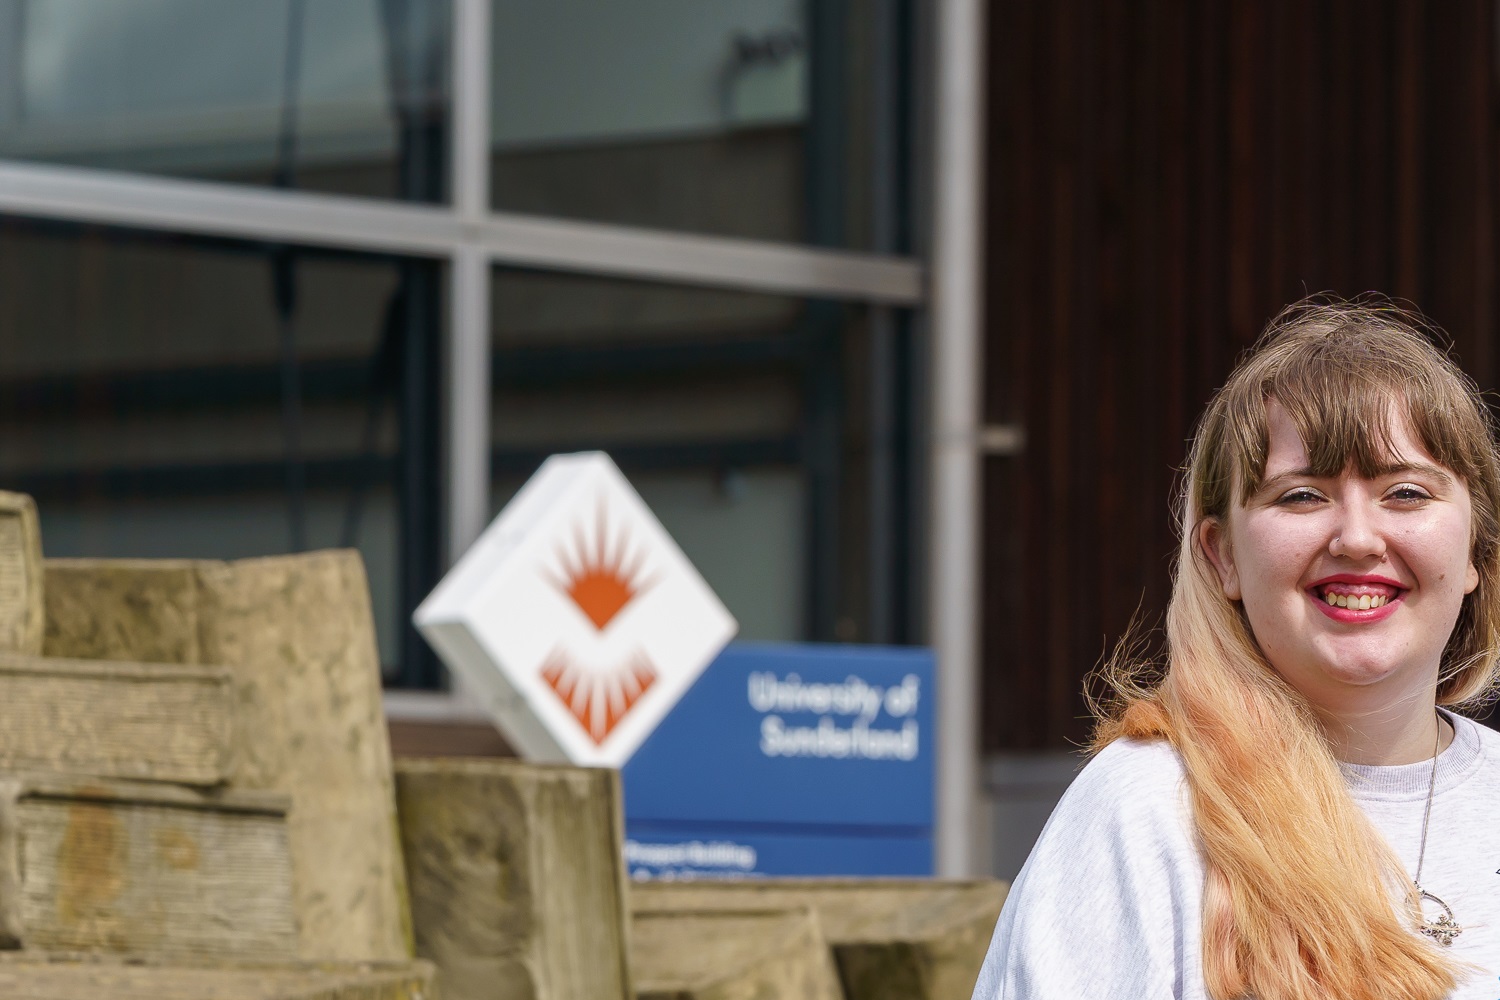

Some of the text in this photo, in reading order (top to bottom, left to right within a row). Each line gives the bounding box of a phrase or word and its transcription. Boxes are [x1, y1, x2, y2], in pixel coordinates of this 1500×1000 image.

[748, 671, 920, 724] University of
[760, 714, 919, 761] Sunderland
